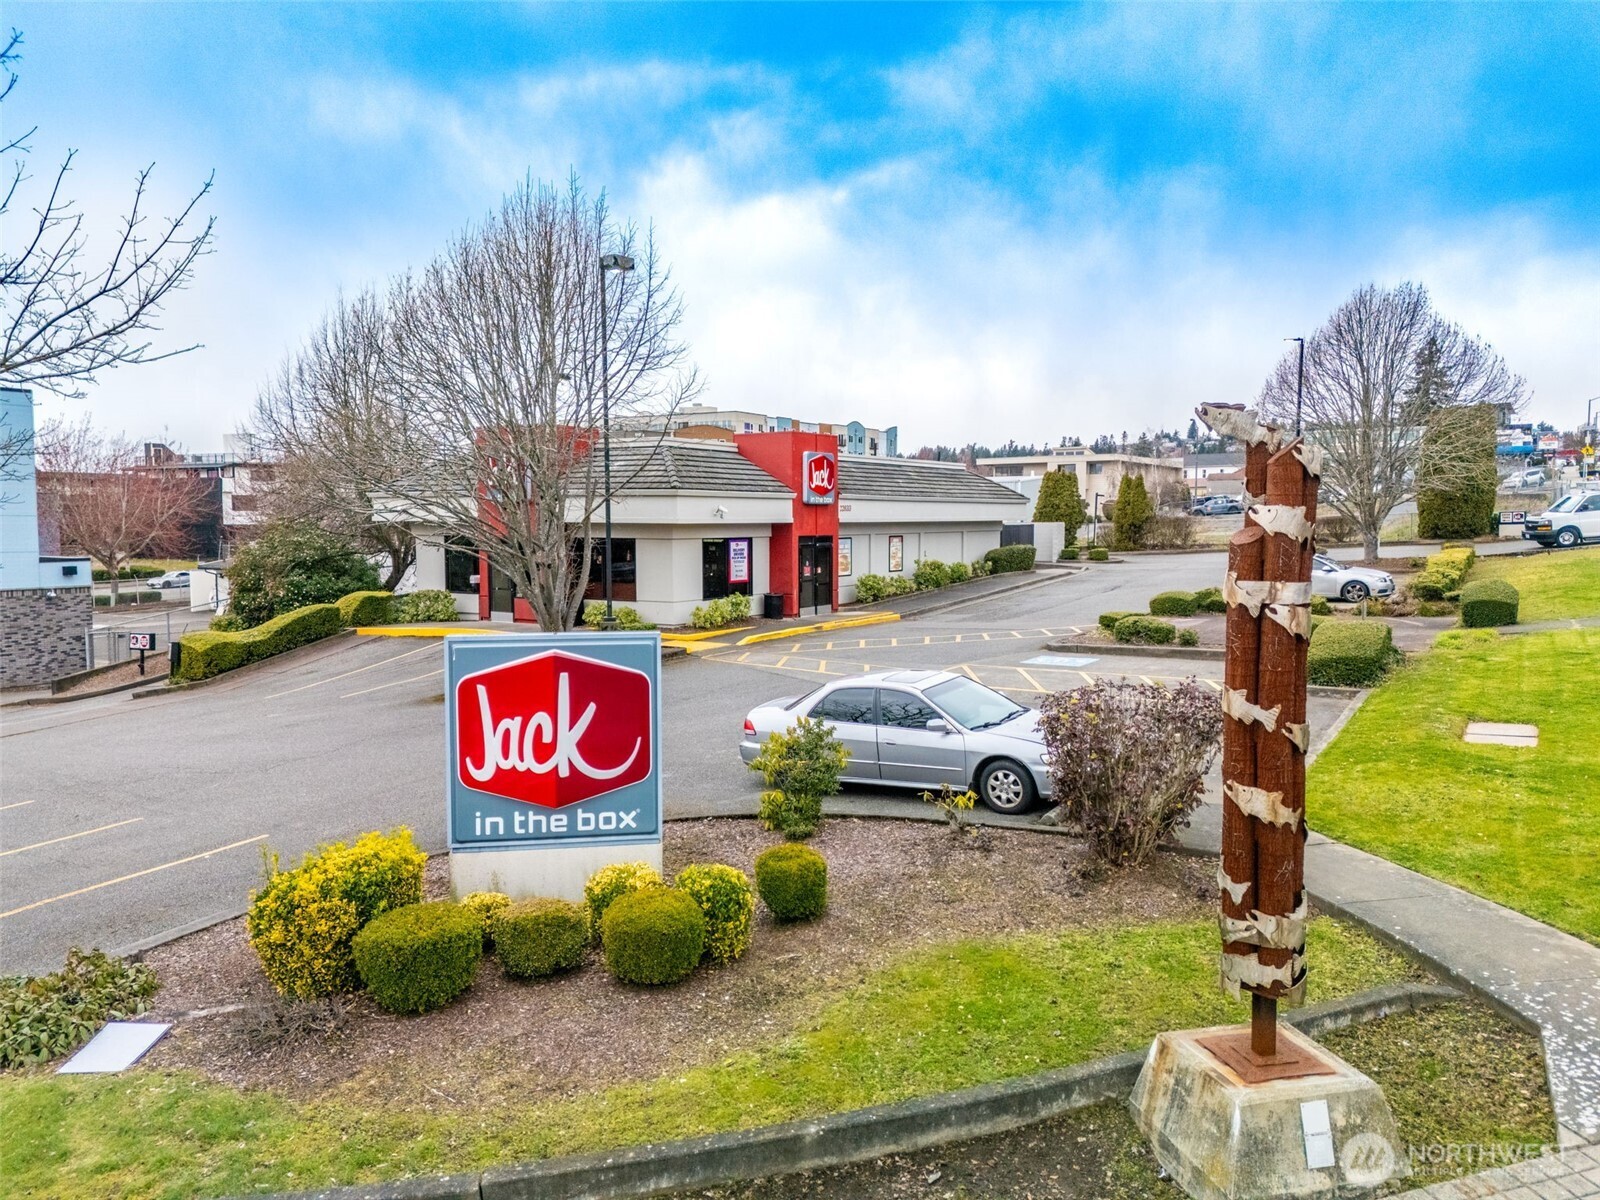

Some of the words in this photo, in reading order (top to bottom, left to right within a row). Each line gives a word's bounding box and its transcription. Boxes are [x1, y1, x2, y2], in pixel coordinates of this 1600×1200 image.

[810, 459, 834, 489] Jack
[465, 672, 642, 782] Jack
[475, 811, 504, 836] in
[514, 811, 568, 834] the
